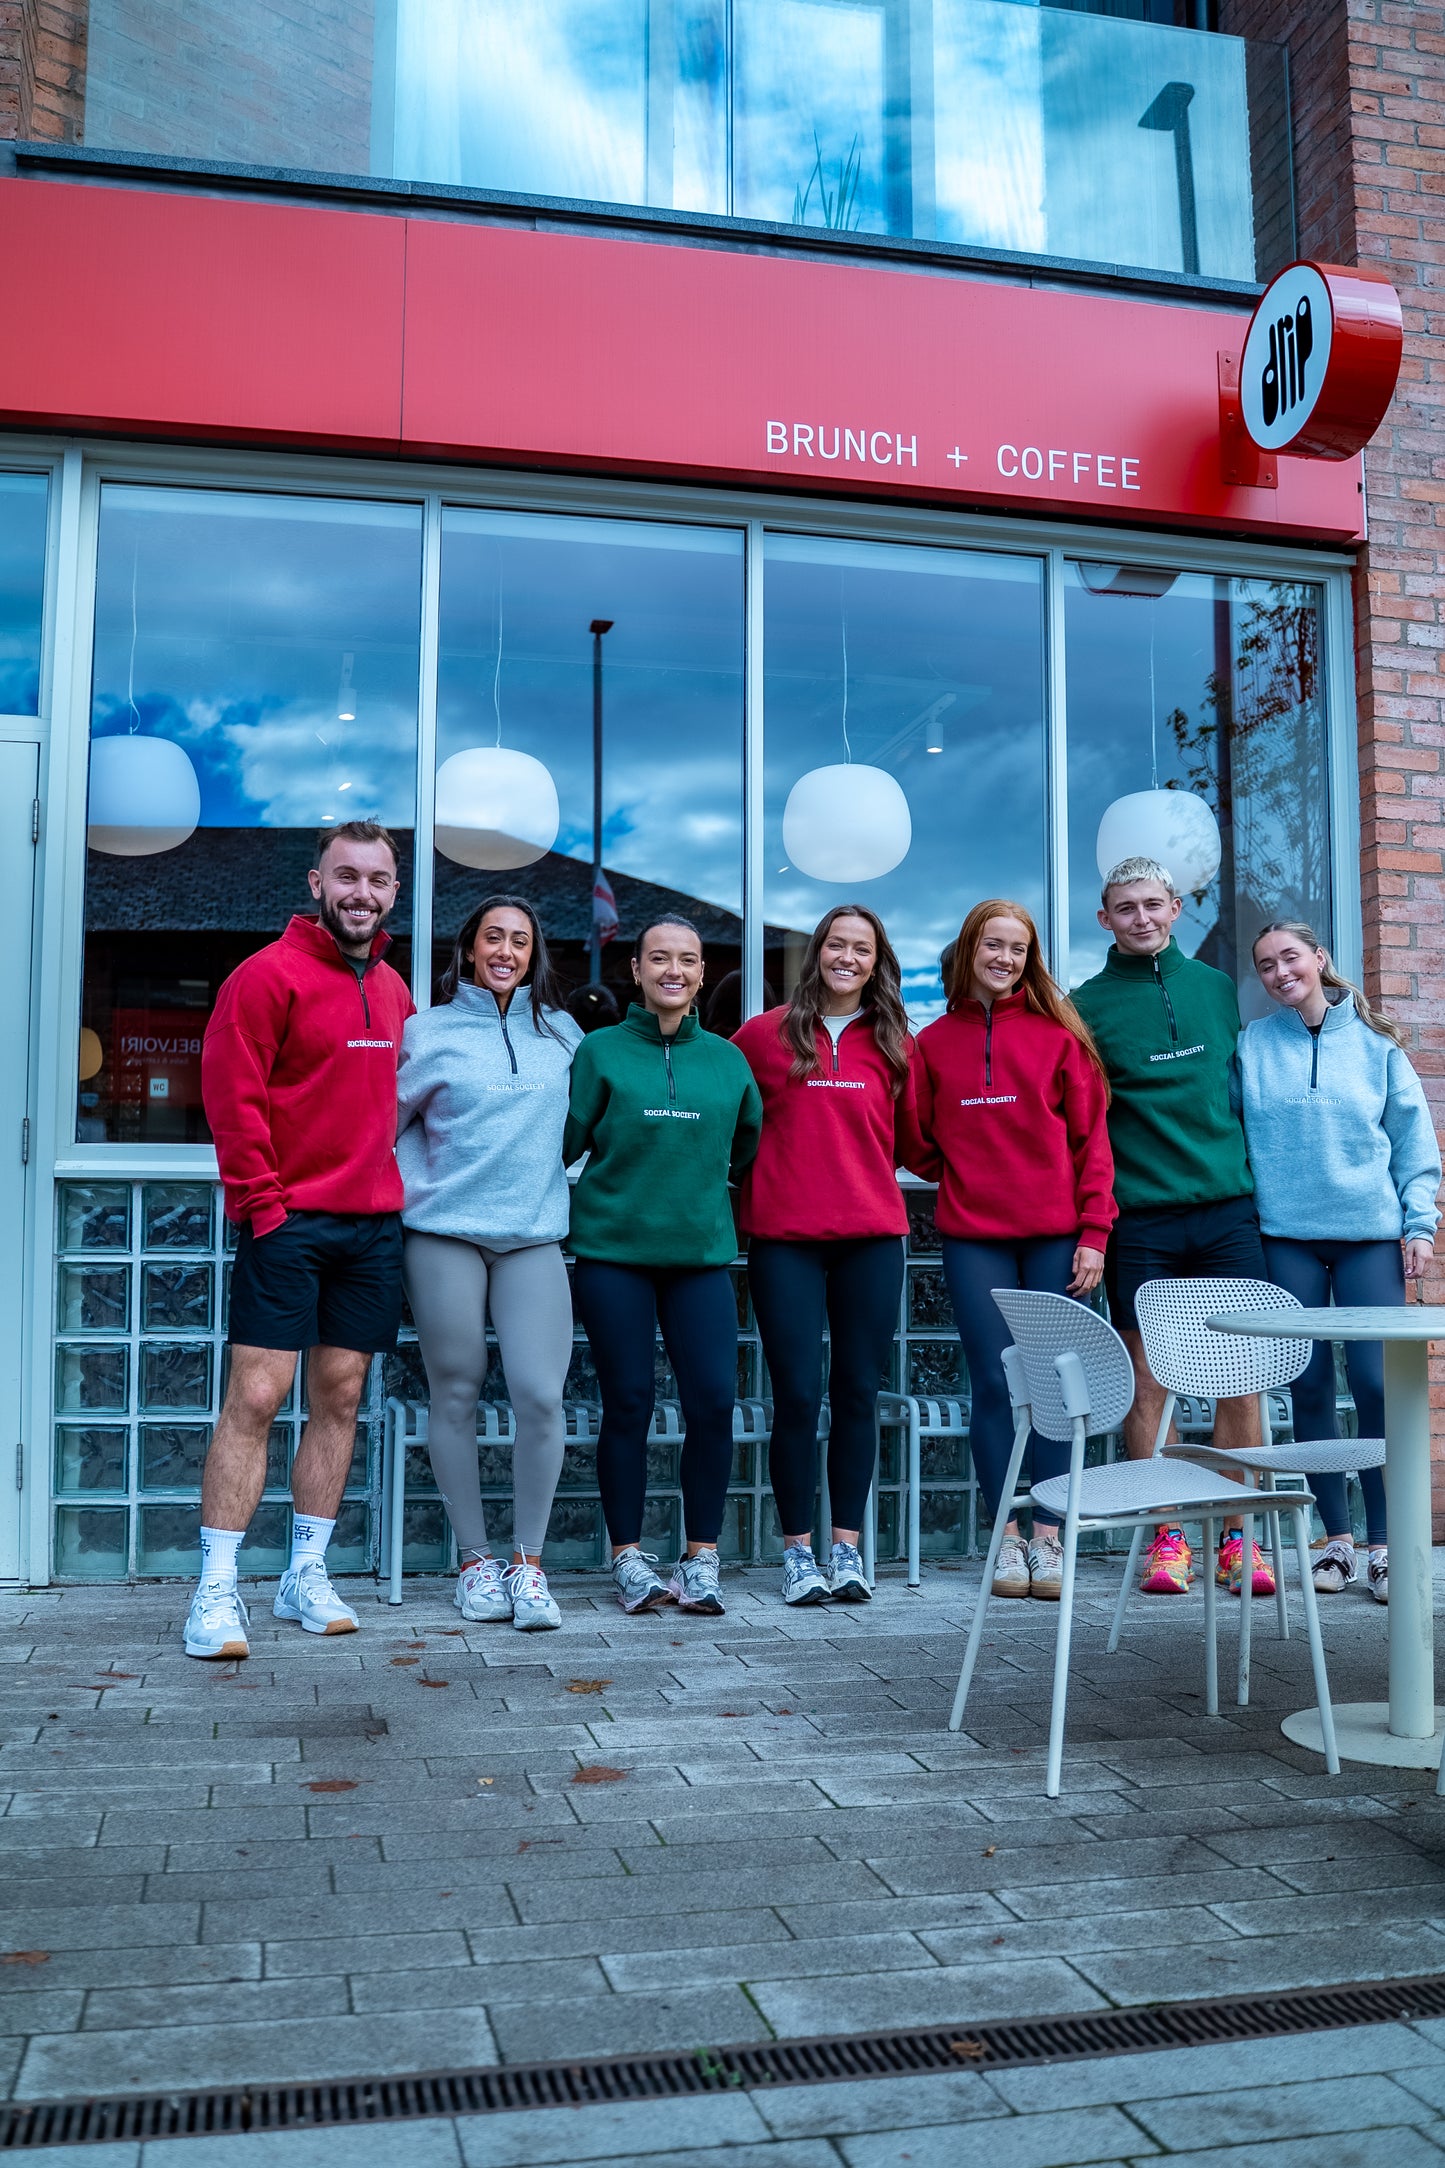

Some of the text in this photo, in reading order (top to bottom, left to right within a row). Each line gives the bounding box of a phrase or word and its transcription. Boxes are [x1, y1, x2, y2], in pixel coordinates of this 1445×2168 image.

[1262, 295, 1313, 426] drip
[766, 420, 1141, 490] BRUNCH + COFFEE
[367, 1040, 393, 1048] SOCIETY
[1149, 1044, 1205, 1062] SOCIAL SOCIETY
[153, 1083, 165, 1092] WC
[487, 1082, 545, 1091] SOCIAL SOCIETY
[835, 1080, 865, 1089] SOCIETY
[960, 1095, 1017, 1106] SOCIAL SOCIETY
[643, 1109, 701, 1120] SOCIAL SOCIETY
